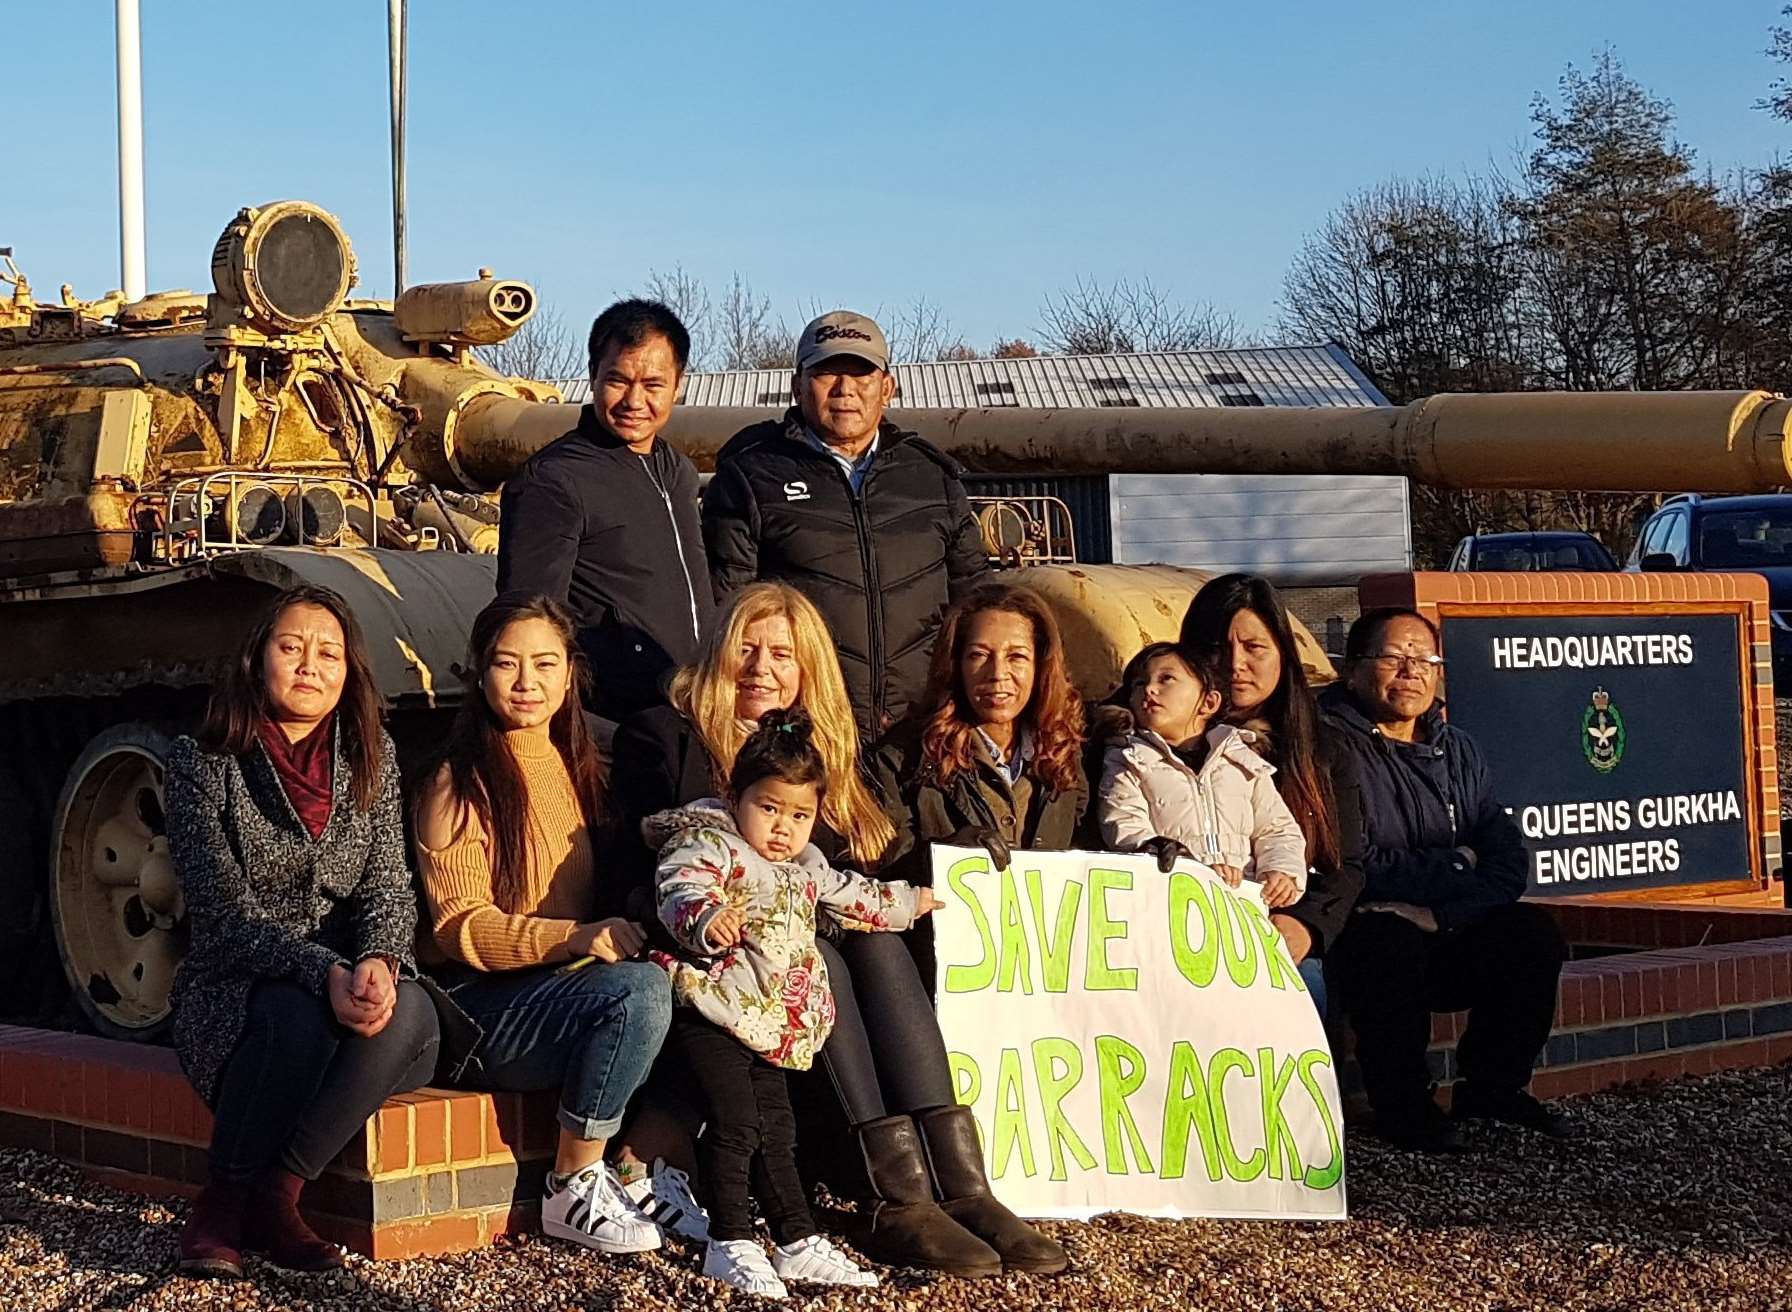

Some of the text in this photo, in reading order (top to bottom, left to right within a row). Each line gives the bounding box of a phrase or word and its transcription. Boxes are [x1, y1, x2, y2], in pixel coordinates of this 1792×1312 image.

[1493, 634, 1694, 669] HEADQUARTERS
[1521, 790, 1742, 839] QUEENS GURKHA
[1535, 838, 1681, 884] ENGINEERS
[945, 856, 1306, 995] SAVE OUR
